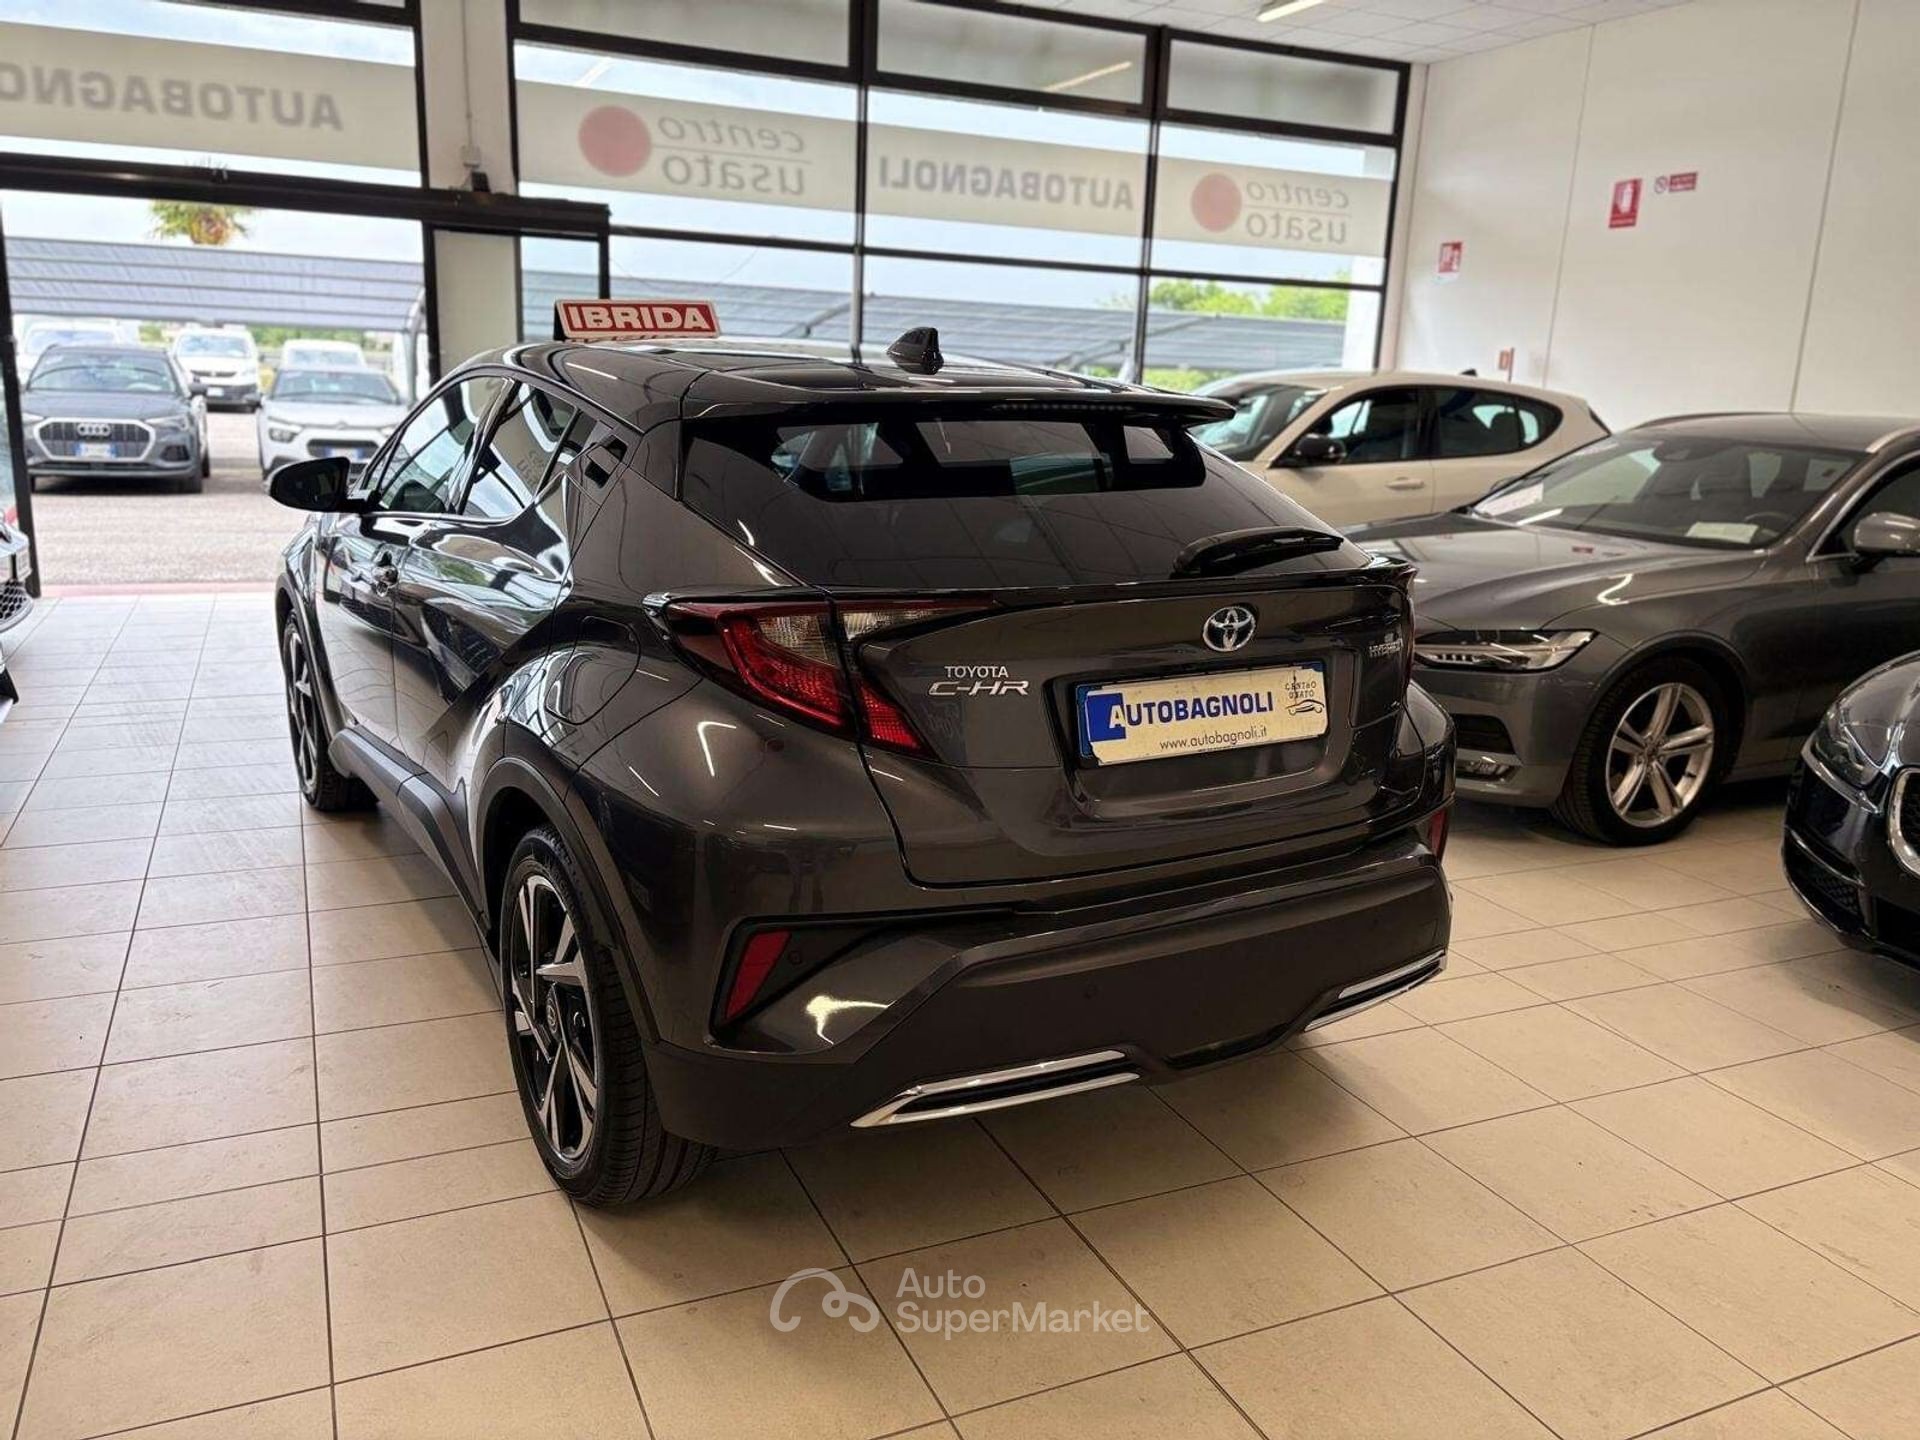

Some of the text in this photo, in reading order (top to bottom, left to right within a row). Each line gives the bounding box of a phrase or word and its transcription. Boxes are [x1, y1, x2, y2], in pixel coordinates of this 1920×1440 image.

[567, 305, 711, 329] IBRIDA
[944, 665, 1009, 678] TOYOTA
[928, 680, 1029, 696] C-HR
[1109, 691, 1274, 729] AUTOBAGNOLI
[1159, 726, 1268, 750] www.autobagnoli.it
